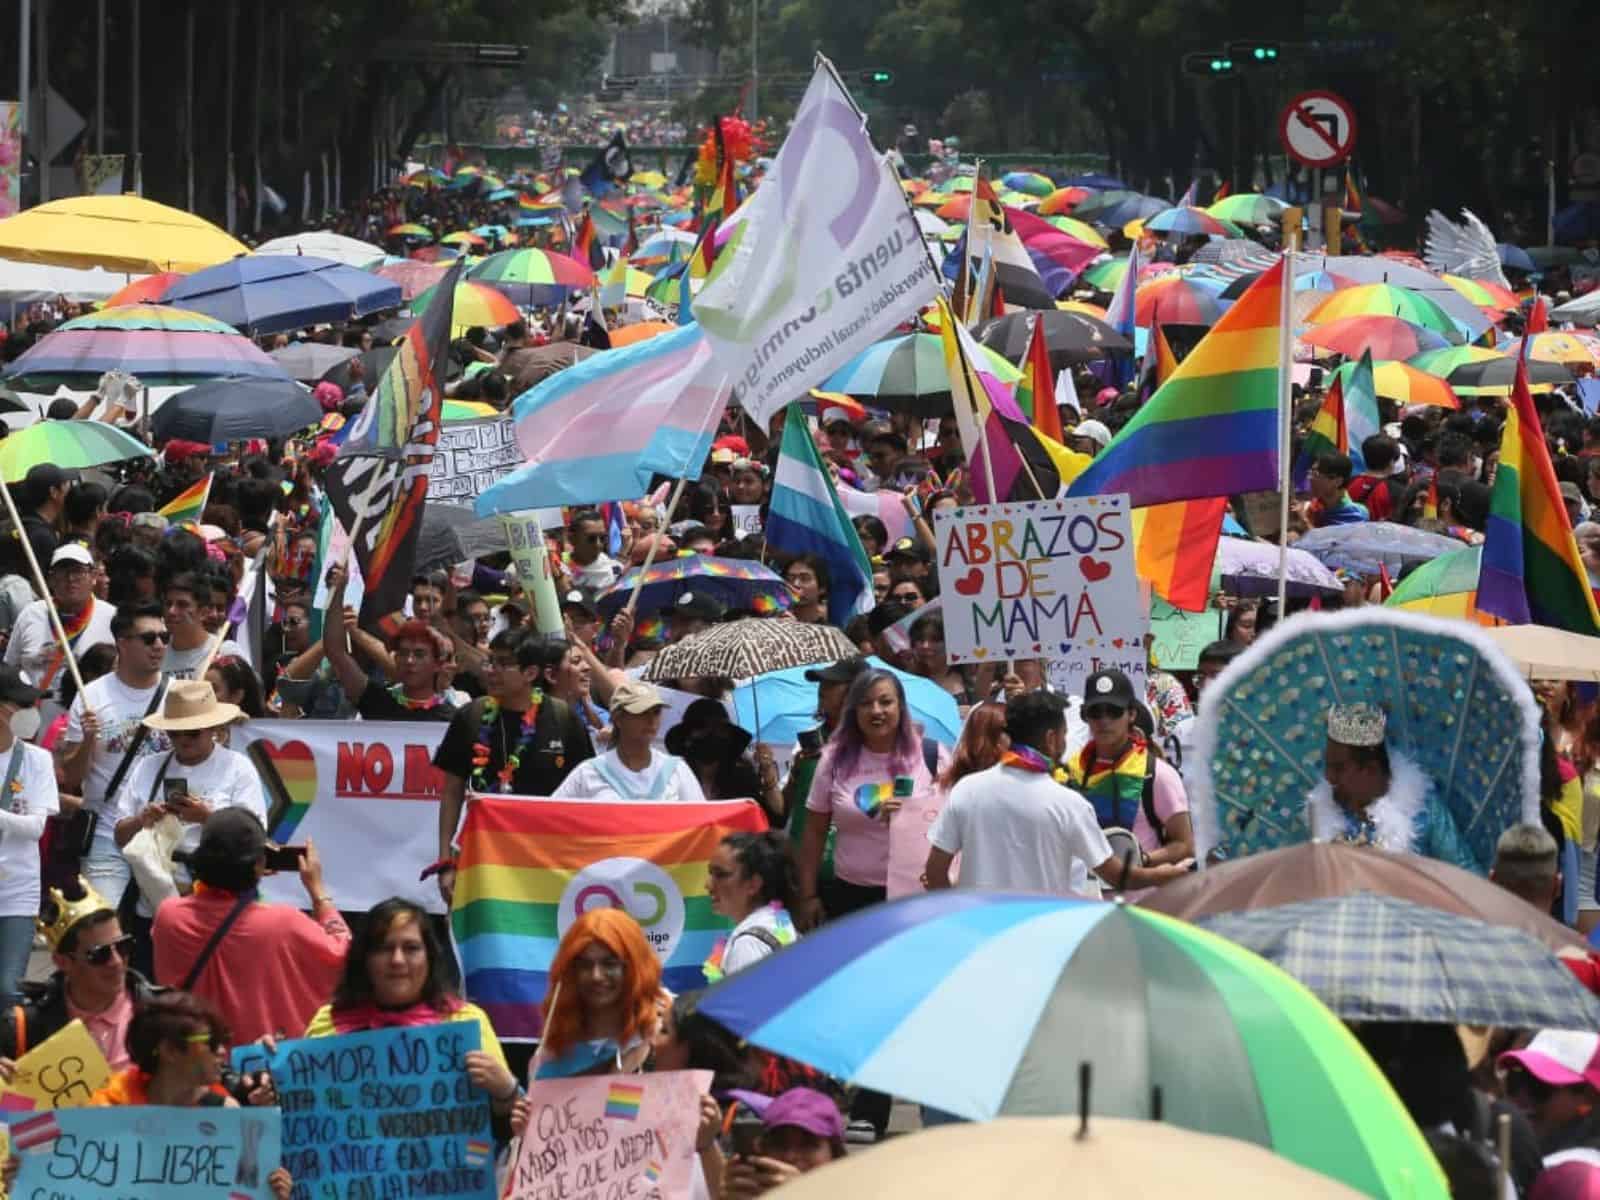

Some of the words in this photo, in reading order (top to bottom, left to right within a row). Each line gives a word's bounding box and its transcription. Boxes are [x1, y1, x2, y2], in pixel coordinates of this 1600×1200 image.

[943, 511, 1125, 567] ABRAZOS
[995, 557, 1056, 600] DE
[336, 742, 393, 793] NO
[288, 1045, 376, 1085] AMOR
[389, 1031, 428, 1075] NO
[47, 1134, 119, 1188] SOY
[131, 1140, 234, 1187] LIBRE
